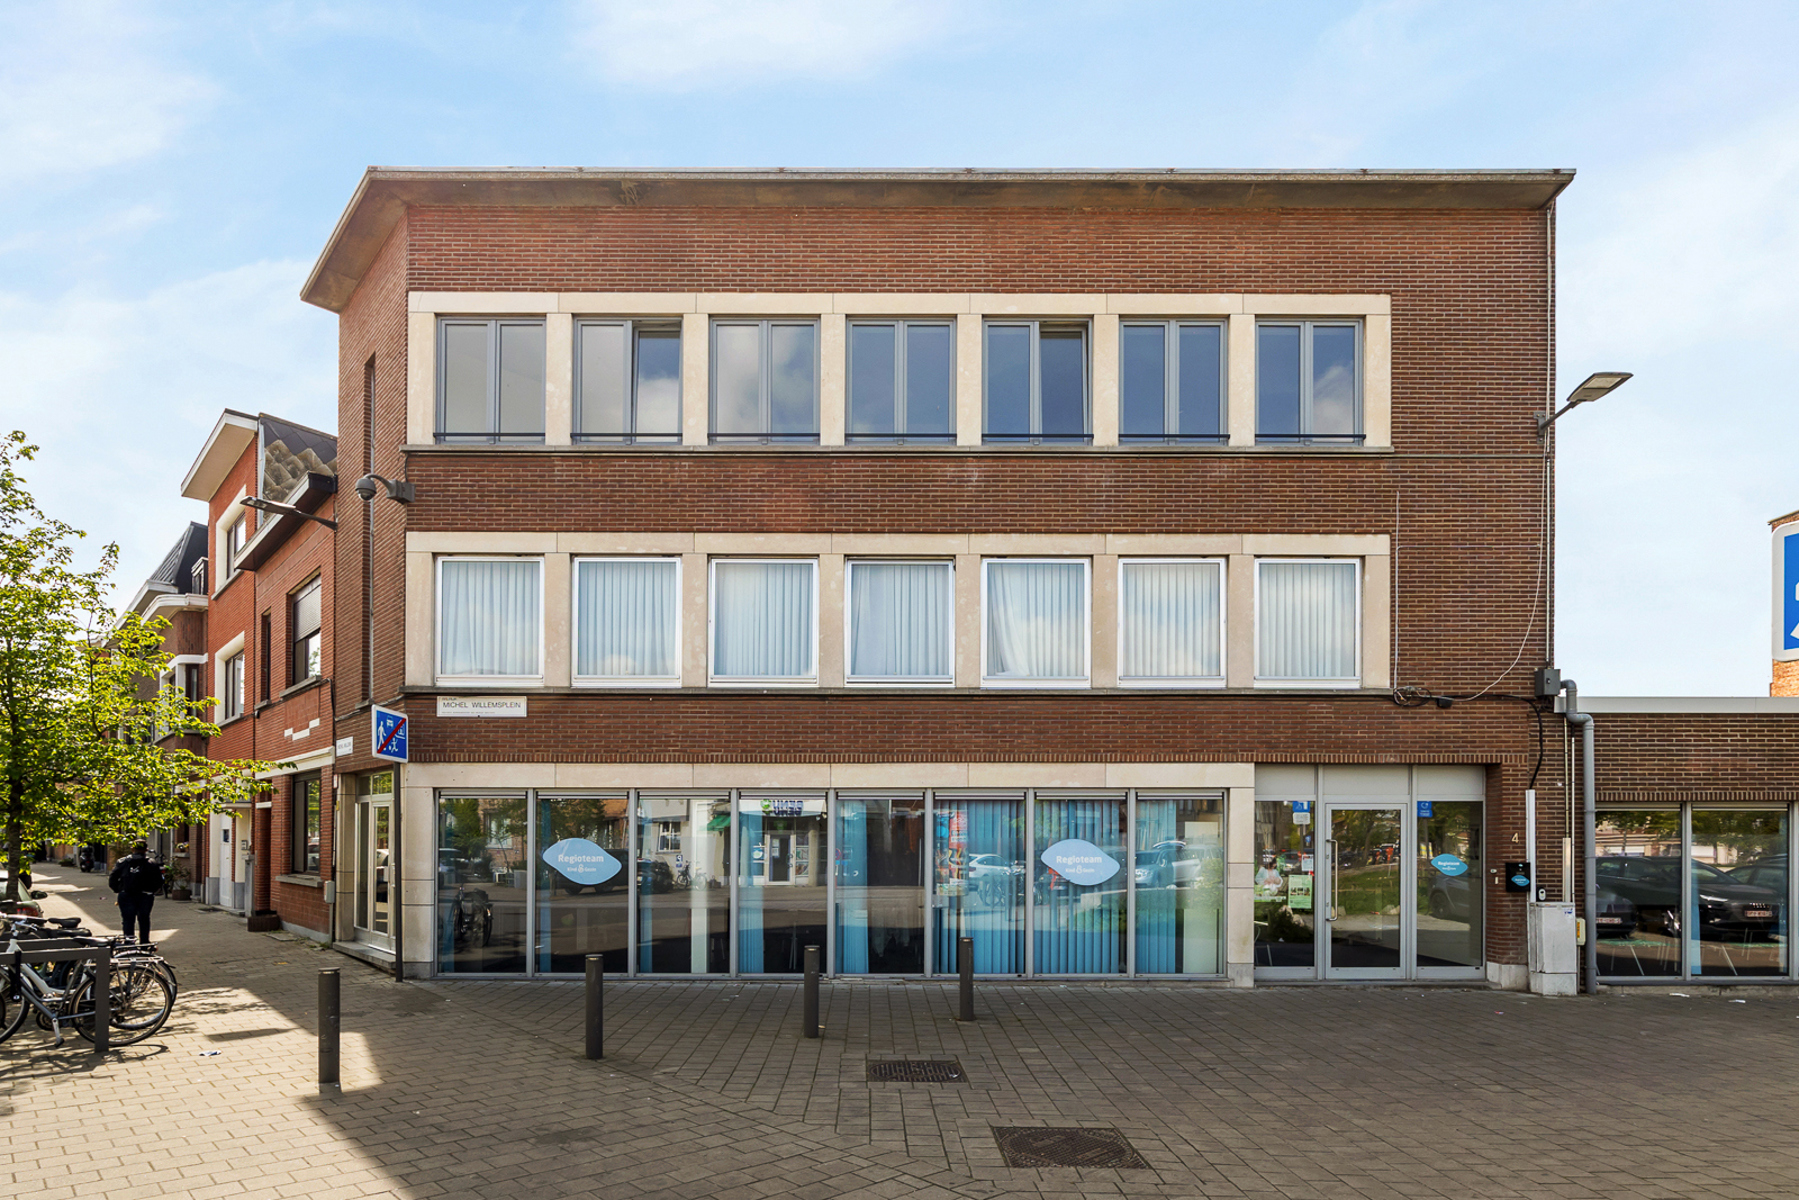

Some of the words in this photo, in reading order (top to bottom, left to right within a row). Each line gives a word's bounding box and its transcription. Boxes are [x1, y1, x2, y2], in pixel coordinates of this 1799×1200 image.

[1511, 832, 1519, 843] 4
[557, 854, 604, 864] Regioteam
[1056, 855, 1102, 865] Regioteam
